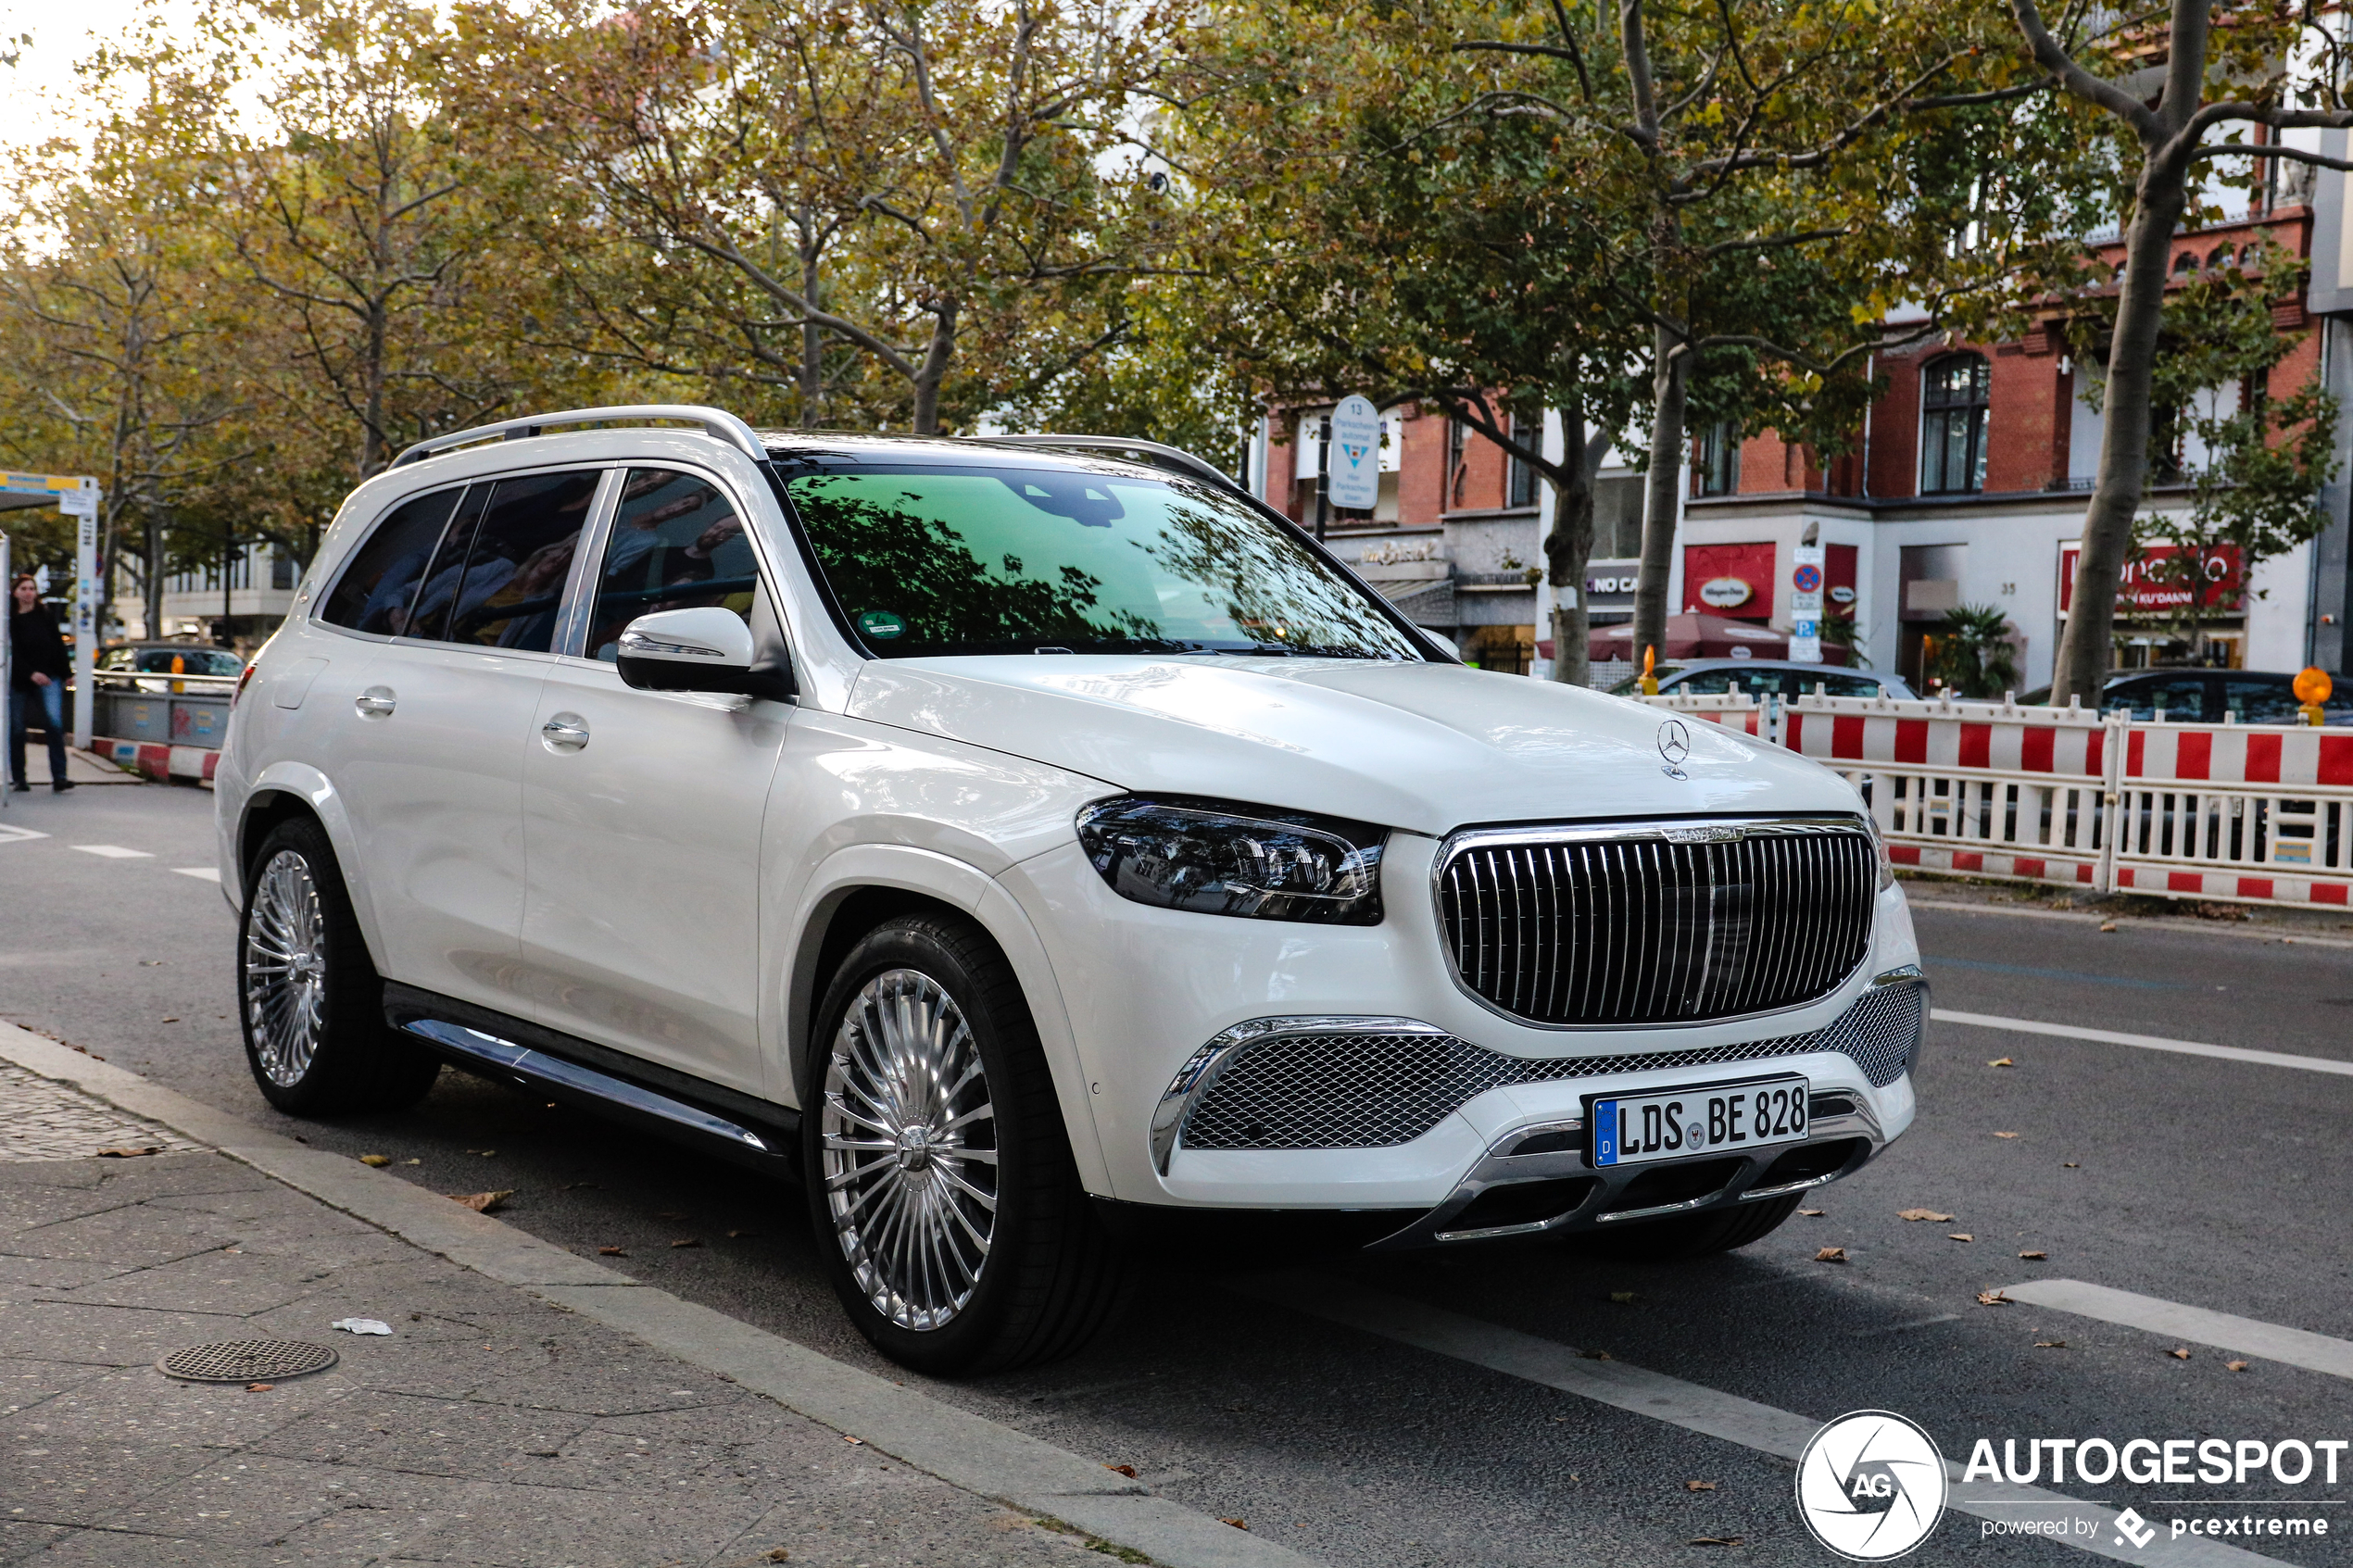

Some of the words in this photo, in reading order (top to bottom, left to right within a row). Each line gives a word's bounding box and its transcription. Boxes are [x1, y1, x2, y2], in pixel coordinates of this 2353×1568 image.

[1351, 404, 1363, 416] 13
[2001, 583, 2016, 596] 35
[1798, 621, 1810, 636] P
[1677, 827, 1737, 842] MAYBACH
[1619, 1101, 1683, 1156] LDS
[1708, 1094, 1746, 1145] BE
[1755, 1086, 1806, 1138] 828
[1602, 1140, 1611, 1154] D
